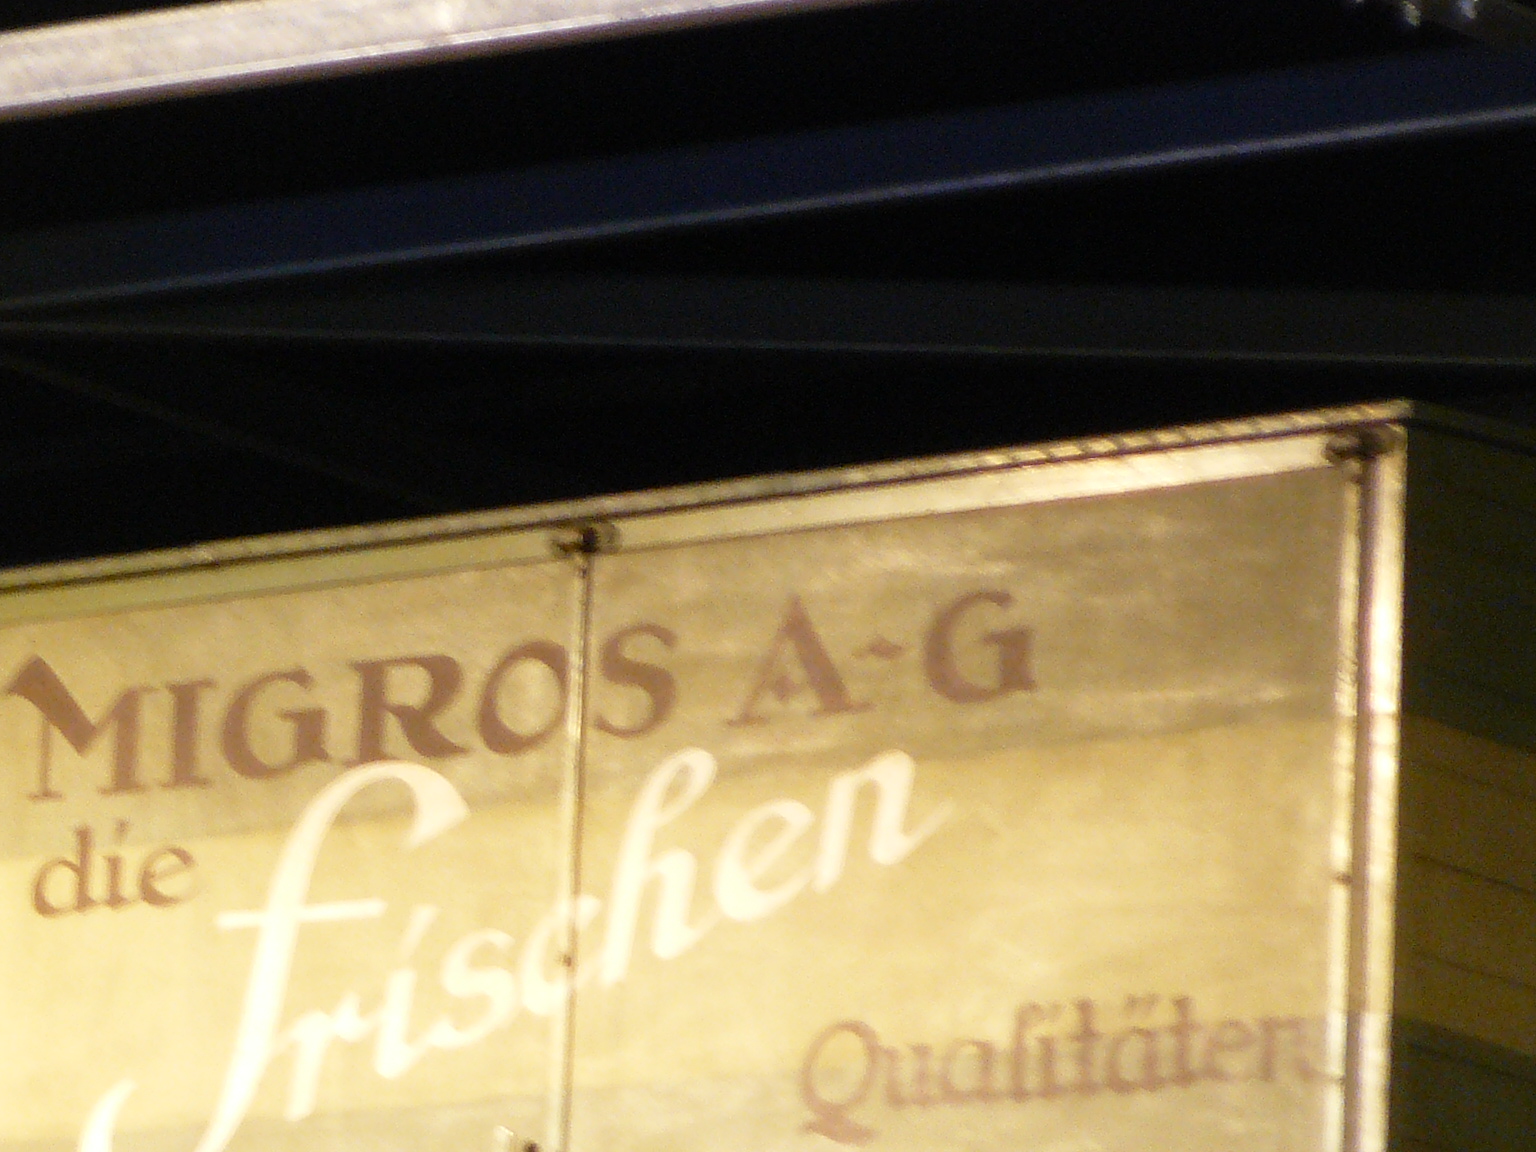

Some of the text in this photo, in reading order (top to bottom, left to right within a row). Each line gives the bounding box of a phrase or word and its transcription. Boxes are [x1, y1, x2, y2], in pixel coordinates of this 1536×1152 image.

[7, 591, 1037, 800] MIGROS A-G
[33, 819, 196, 918] die
[801, 993, 1340, 1144] Qualitäten
